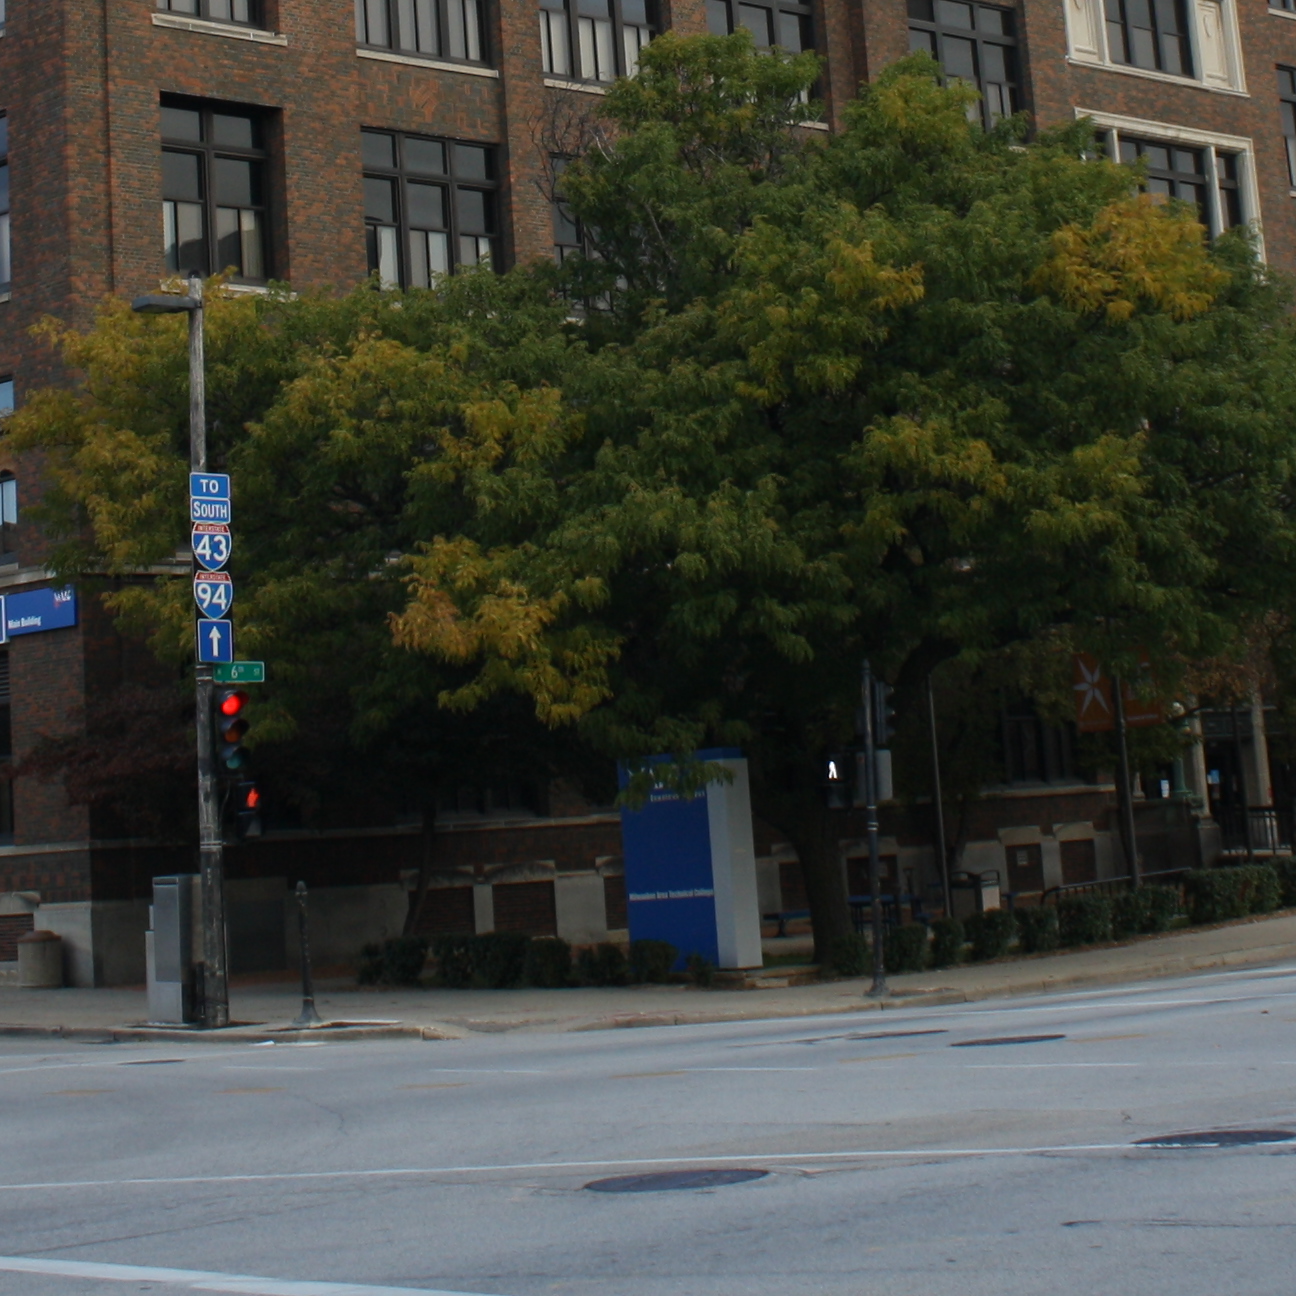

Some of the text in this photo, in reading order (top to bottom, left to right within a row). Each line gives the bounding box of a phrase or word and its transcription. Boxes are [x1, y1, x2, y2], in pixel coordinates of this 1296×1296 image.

[200, 479, 219, 493] TO
[193, 501, 227, 518] SOUTH
[197, 525, 225, 533] INTERSTATE
[196, 535, 227, 561] 43
[197, 583, 227, 610] 94
[21, 615, 41, 627] Building
